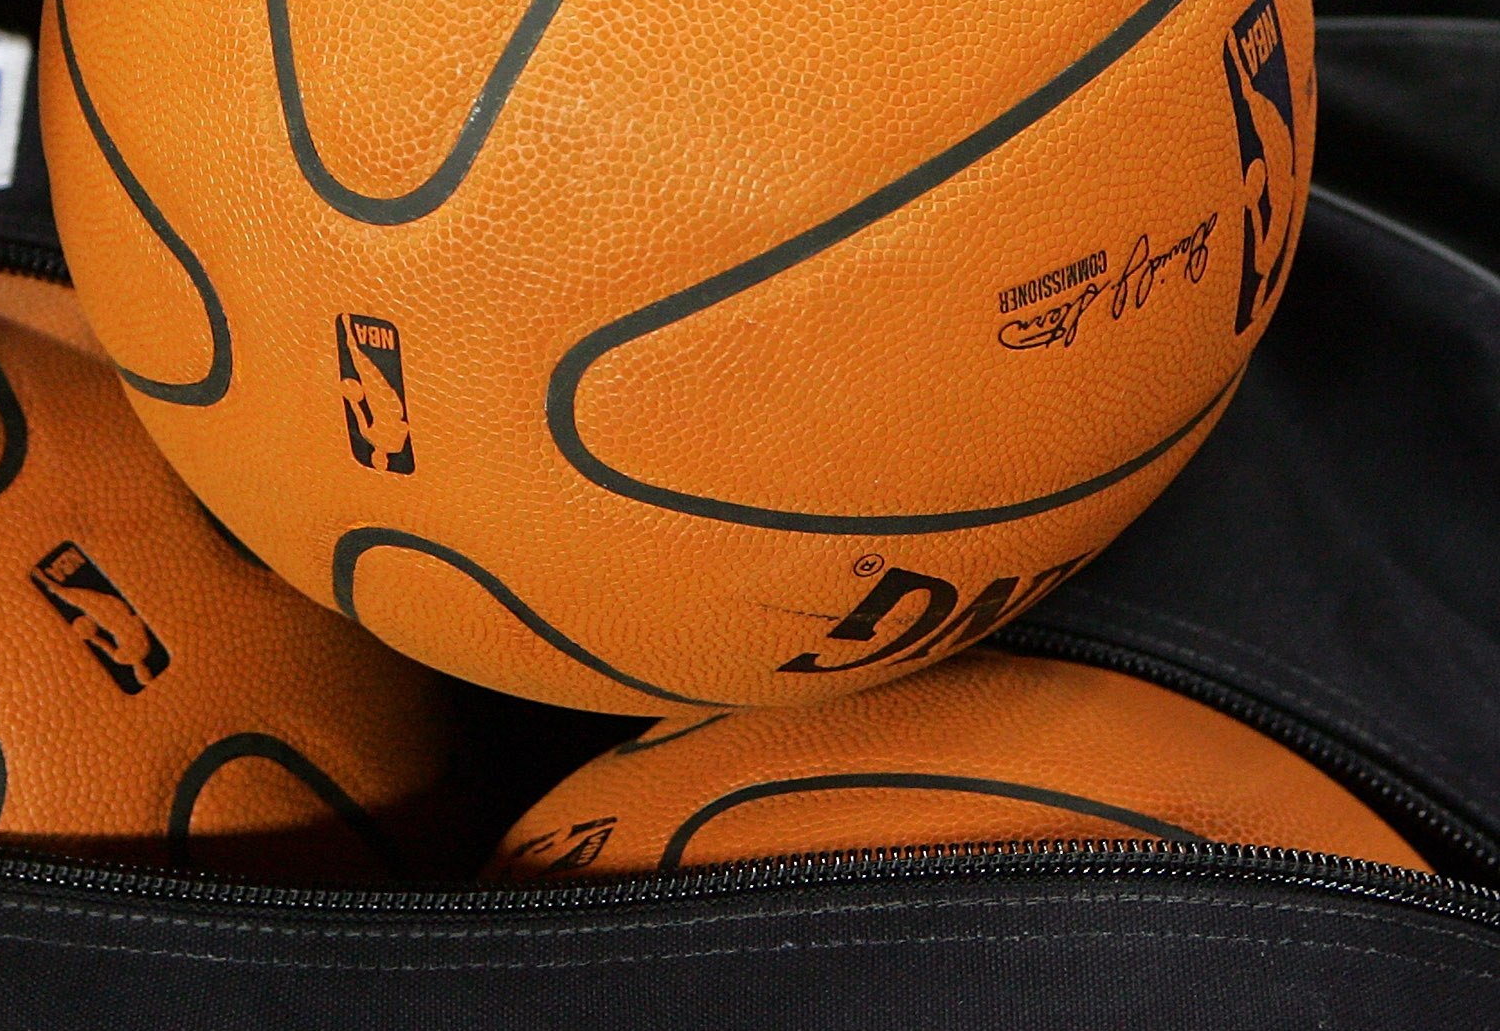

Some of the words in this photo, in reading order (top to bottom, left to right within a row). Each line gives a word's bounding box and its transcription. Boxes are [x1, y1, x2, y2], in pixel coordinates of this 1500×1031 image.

[1241, 4, 1278, 77] NBA
[998, 249, 1108, 314] COMMISSIONER
[355, 323, 394, 351] NBA
